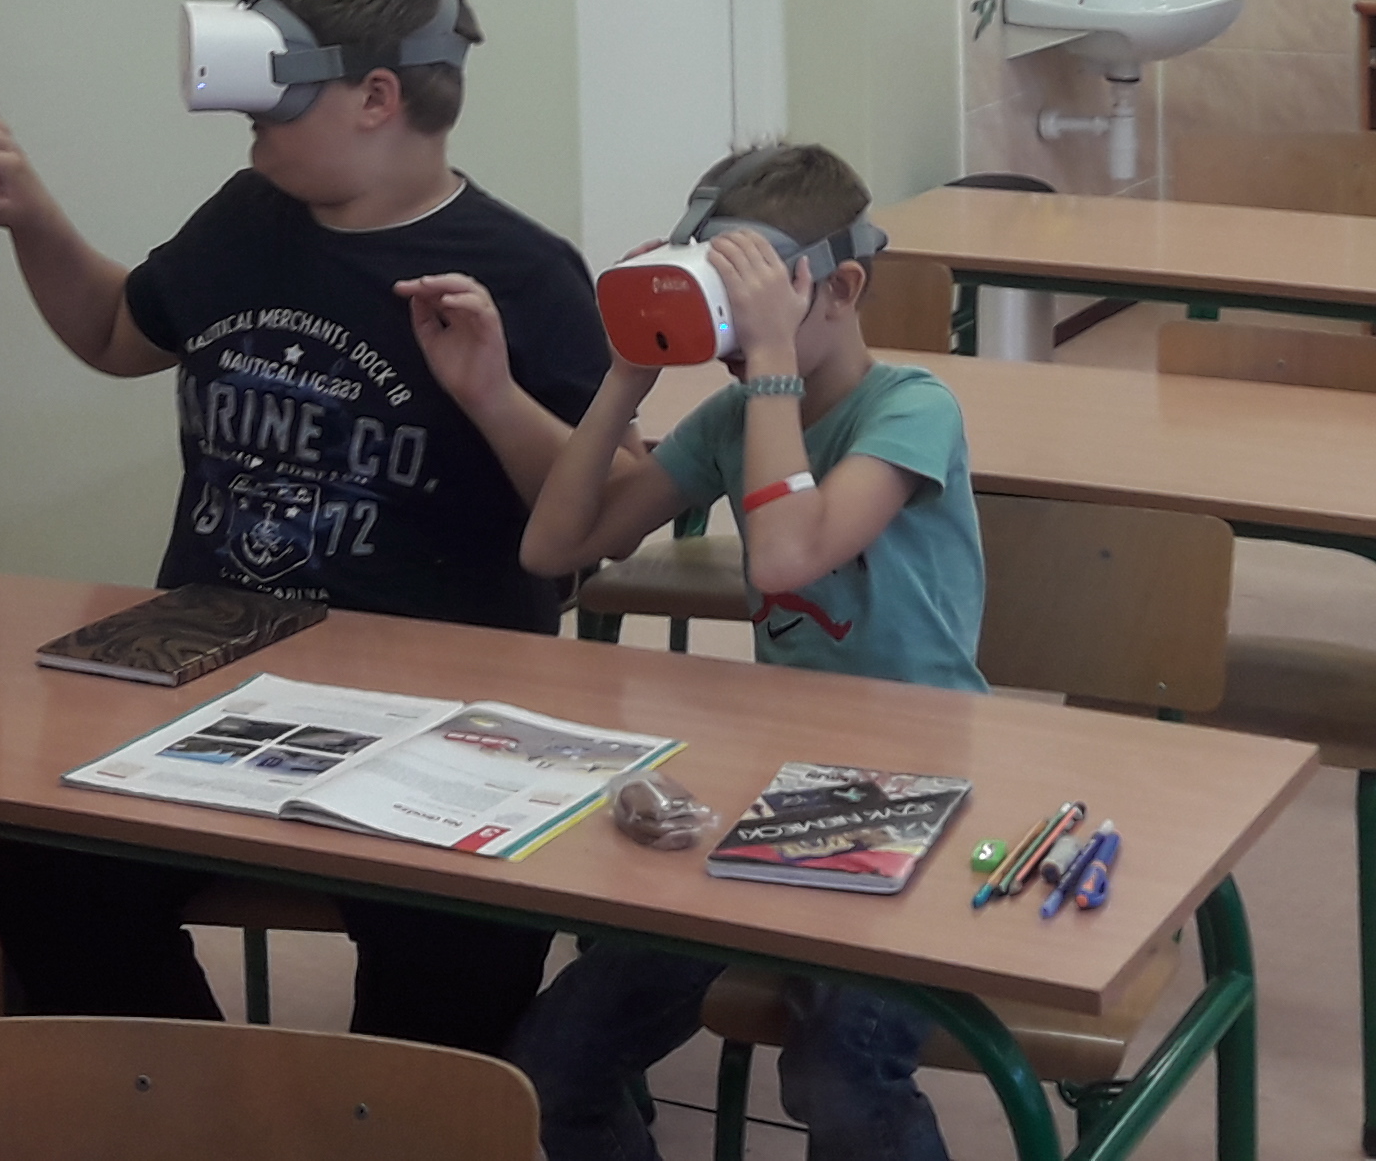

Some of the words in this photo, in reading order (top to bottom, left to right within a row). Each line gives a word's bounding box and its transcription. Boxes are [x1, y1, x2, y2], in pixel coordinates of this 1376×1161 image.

[219, 348, 296, 387] NAUTICAL
[350, 340, 398, 390] DOCK
[386, 383, 413, 407] 18
[347, 416, 439, 494] CO.
[323, 500, 380, 558] 72
